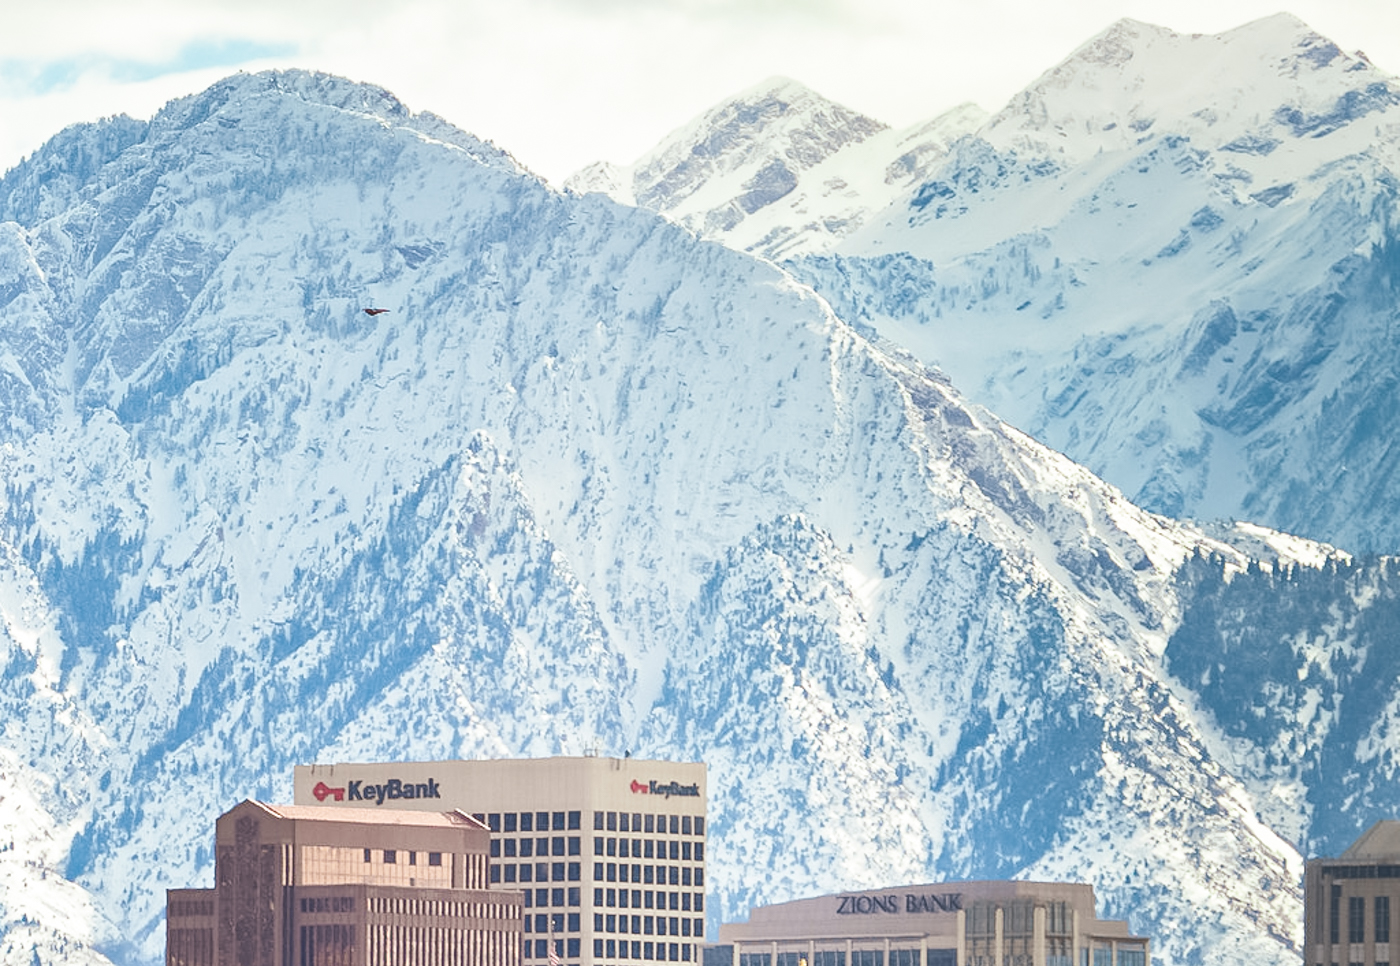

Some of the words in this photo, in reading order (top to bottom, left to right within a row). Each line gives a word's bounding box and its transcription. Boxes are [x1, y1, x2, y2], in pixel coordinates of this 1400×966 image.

[348, 778, 441, 805] KeyBank
[649, 780, 700, 798] KeyBank
[836, 894, 898, 914] ZIONS
[905, 893, 963, 913] BANK
